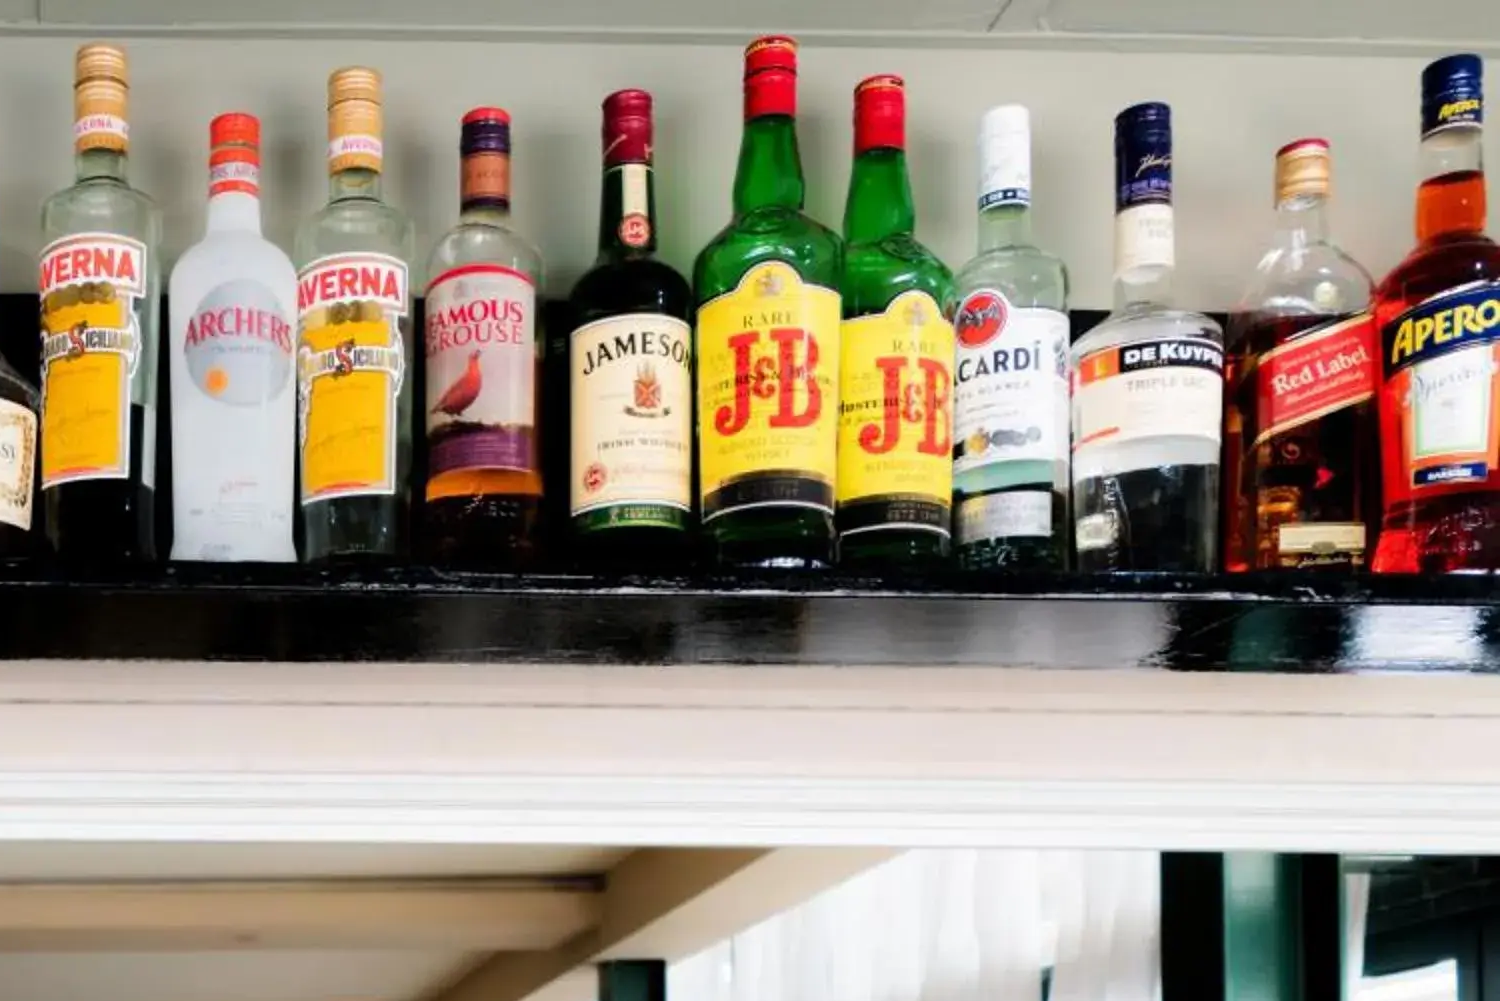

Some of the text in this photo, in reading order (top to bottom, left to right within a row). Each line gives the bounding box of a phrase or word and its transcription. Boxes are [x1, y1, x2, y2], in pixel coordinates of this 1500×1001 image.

[184, 307, 293, 353] ARCHERS
[430, 322, 525, 354] ROUSE
[953, 341, 1041, 387] CARDÍ
[1123, 346, 1156, 365] DE
[1271, 365, 1314, 396] Red
[1315, 345, 1370, 382] Label
[714, 328, 822, 437] J&B
[858, 356, 950, 457] J&B
